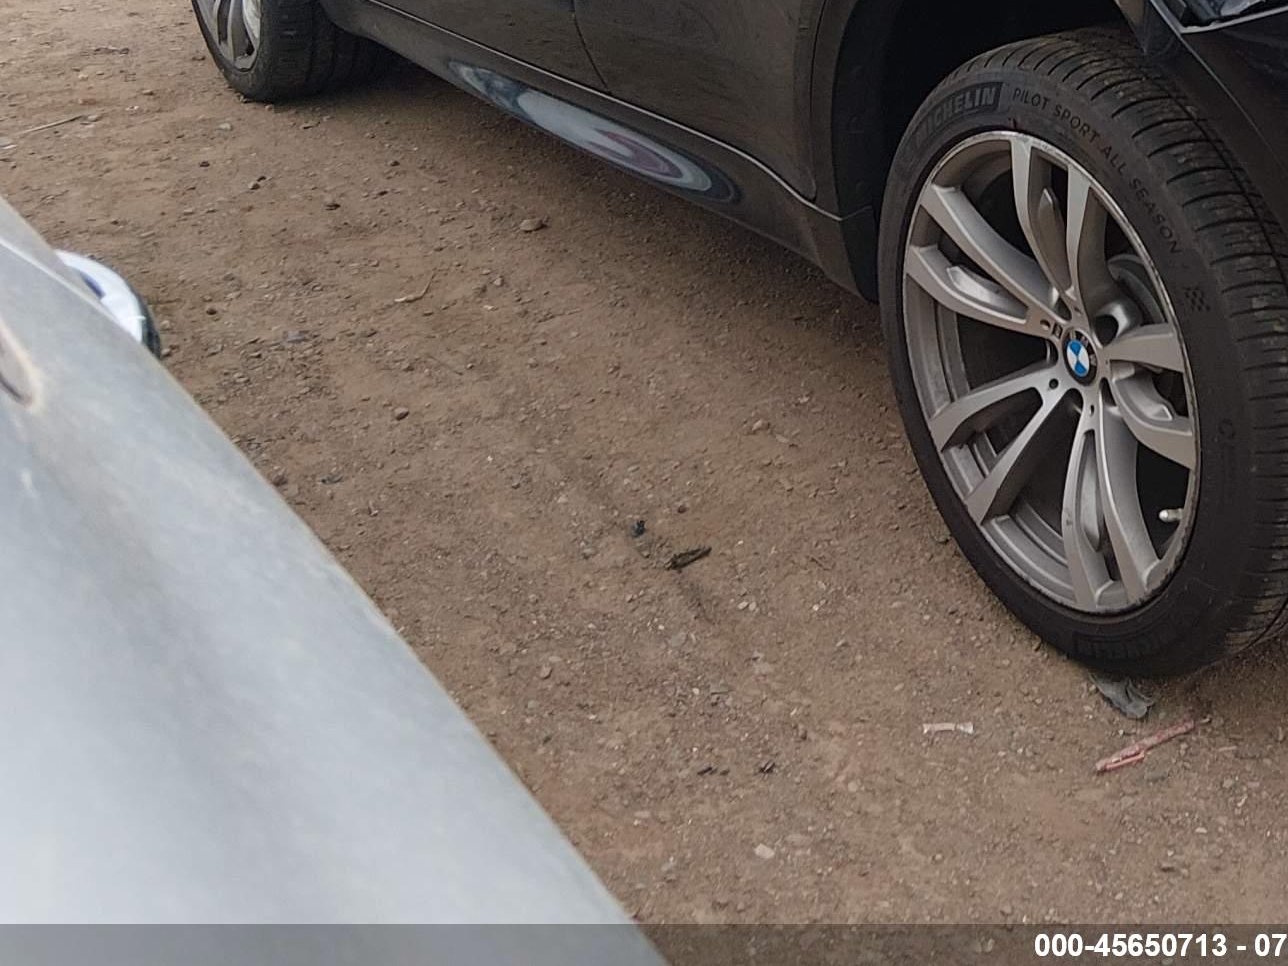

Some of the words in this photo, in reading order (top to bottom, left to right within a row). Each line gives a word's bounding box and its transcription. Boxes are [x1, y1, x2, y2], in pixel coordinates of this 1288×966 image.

[1012, 87, 1050, 111] PILOT
[1053, 104, 1100, 143] SPORT
[1101, 145, 1127, 176] ALL
[1129, 177, 1182, 254] SEASON
